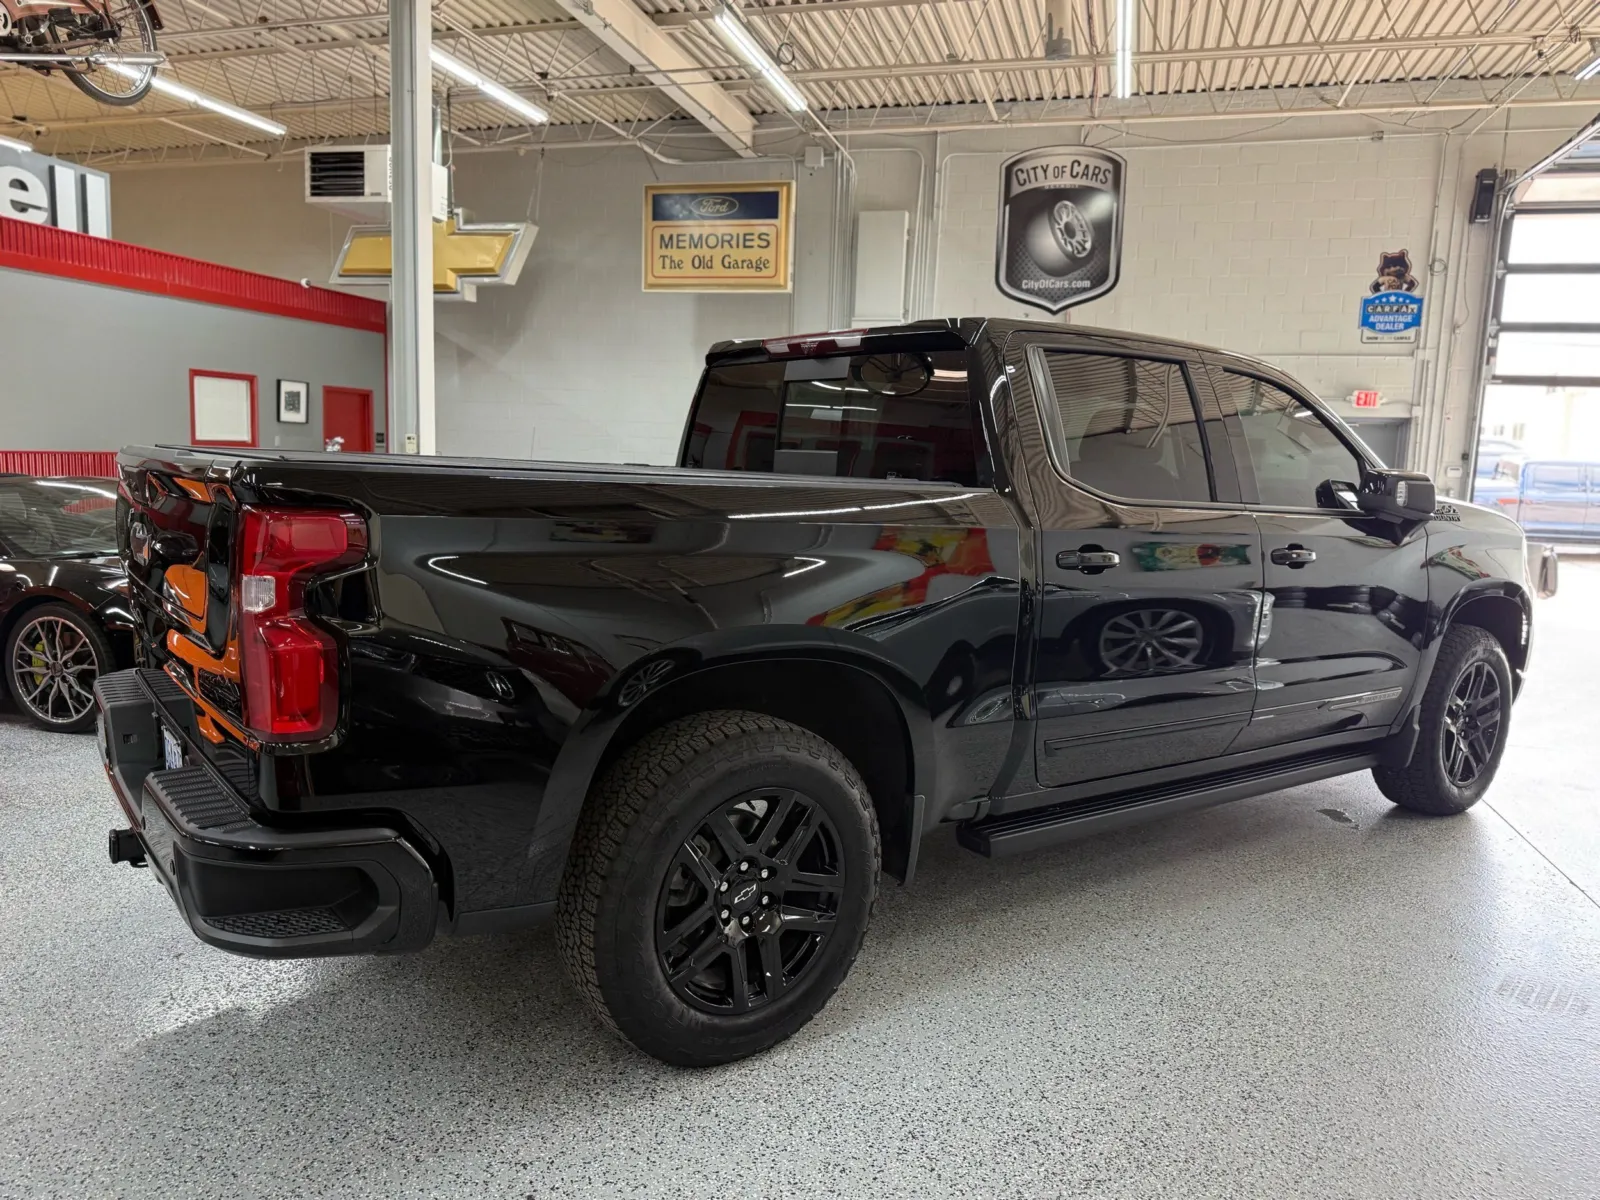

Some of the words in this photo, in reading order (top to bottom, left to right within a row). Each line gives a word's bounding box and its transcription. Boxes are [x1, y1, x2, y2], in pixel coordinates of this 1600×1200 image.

[1015, 164, 1050, 187] CITY
[1053, 165, 1067, 179] OF
[1070, 160, 1112, 185] CARS
[700, 198, 729, 213] Ford
[659, 232, 771, 249] MEMORIES
[658, 255, 684, 270] The
[691, 254, 714, 270] Old
[721, 254, 770, 272] Garage
[1022, 279, 1091, 291] CityOfCars.com
[1367, 304, 1418, 314] CARFAX
[1368, 314, 1413, 323] ADVANTAGE
[1375, 322, 1405, 331] DEALER
[1356, 391, 1378, 407] EXIT
